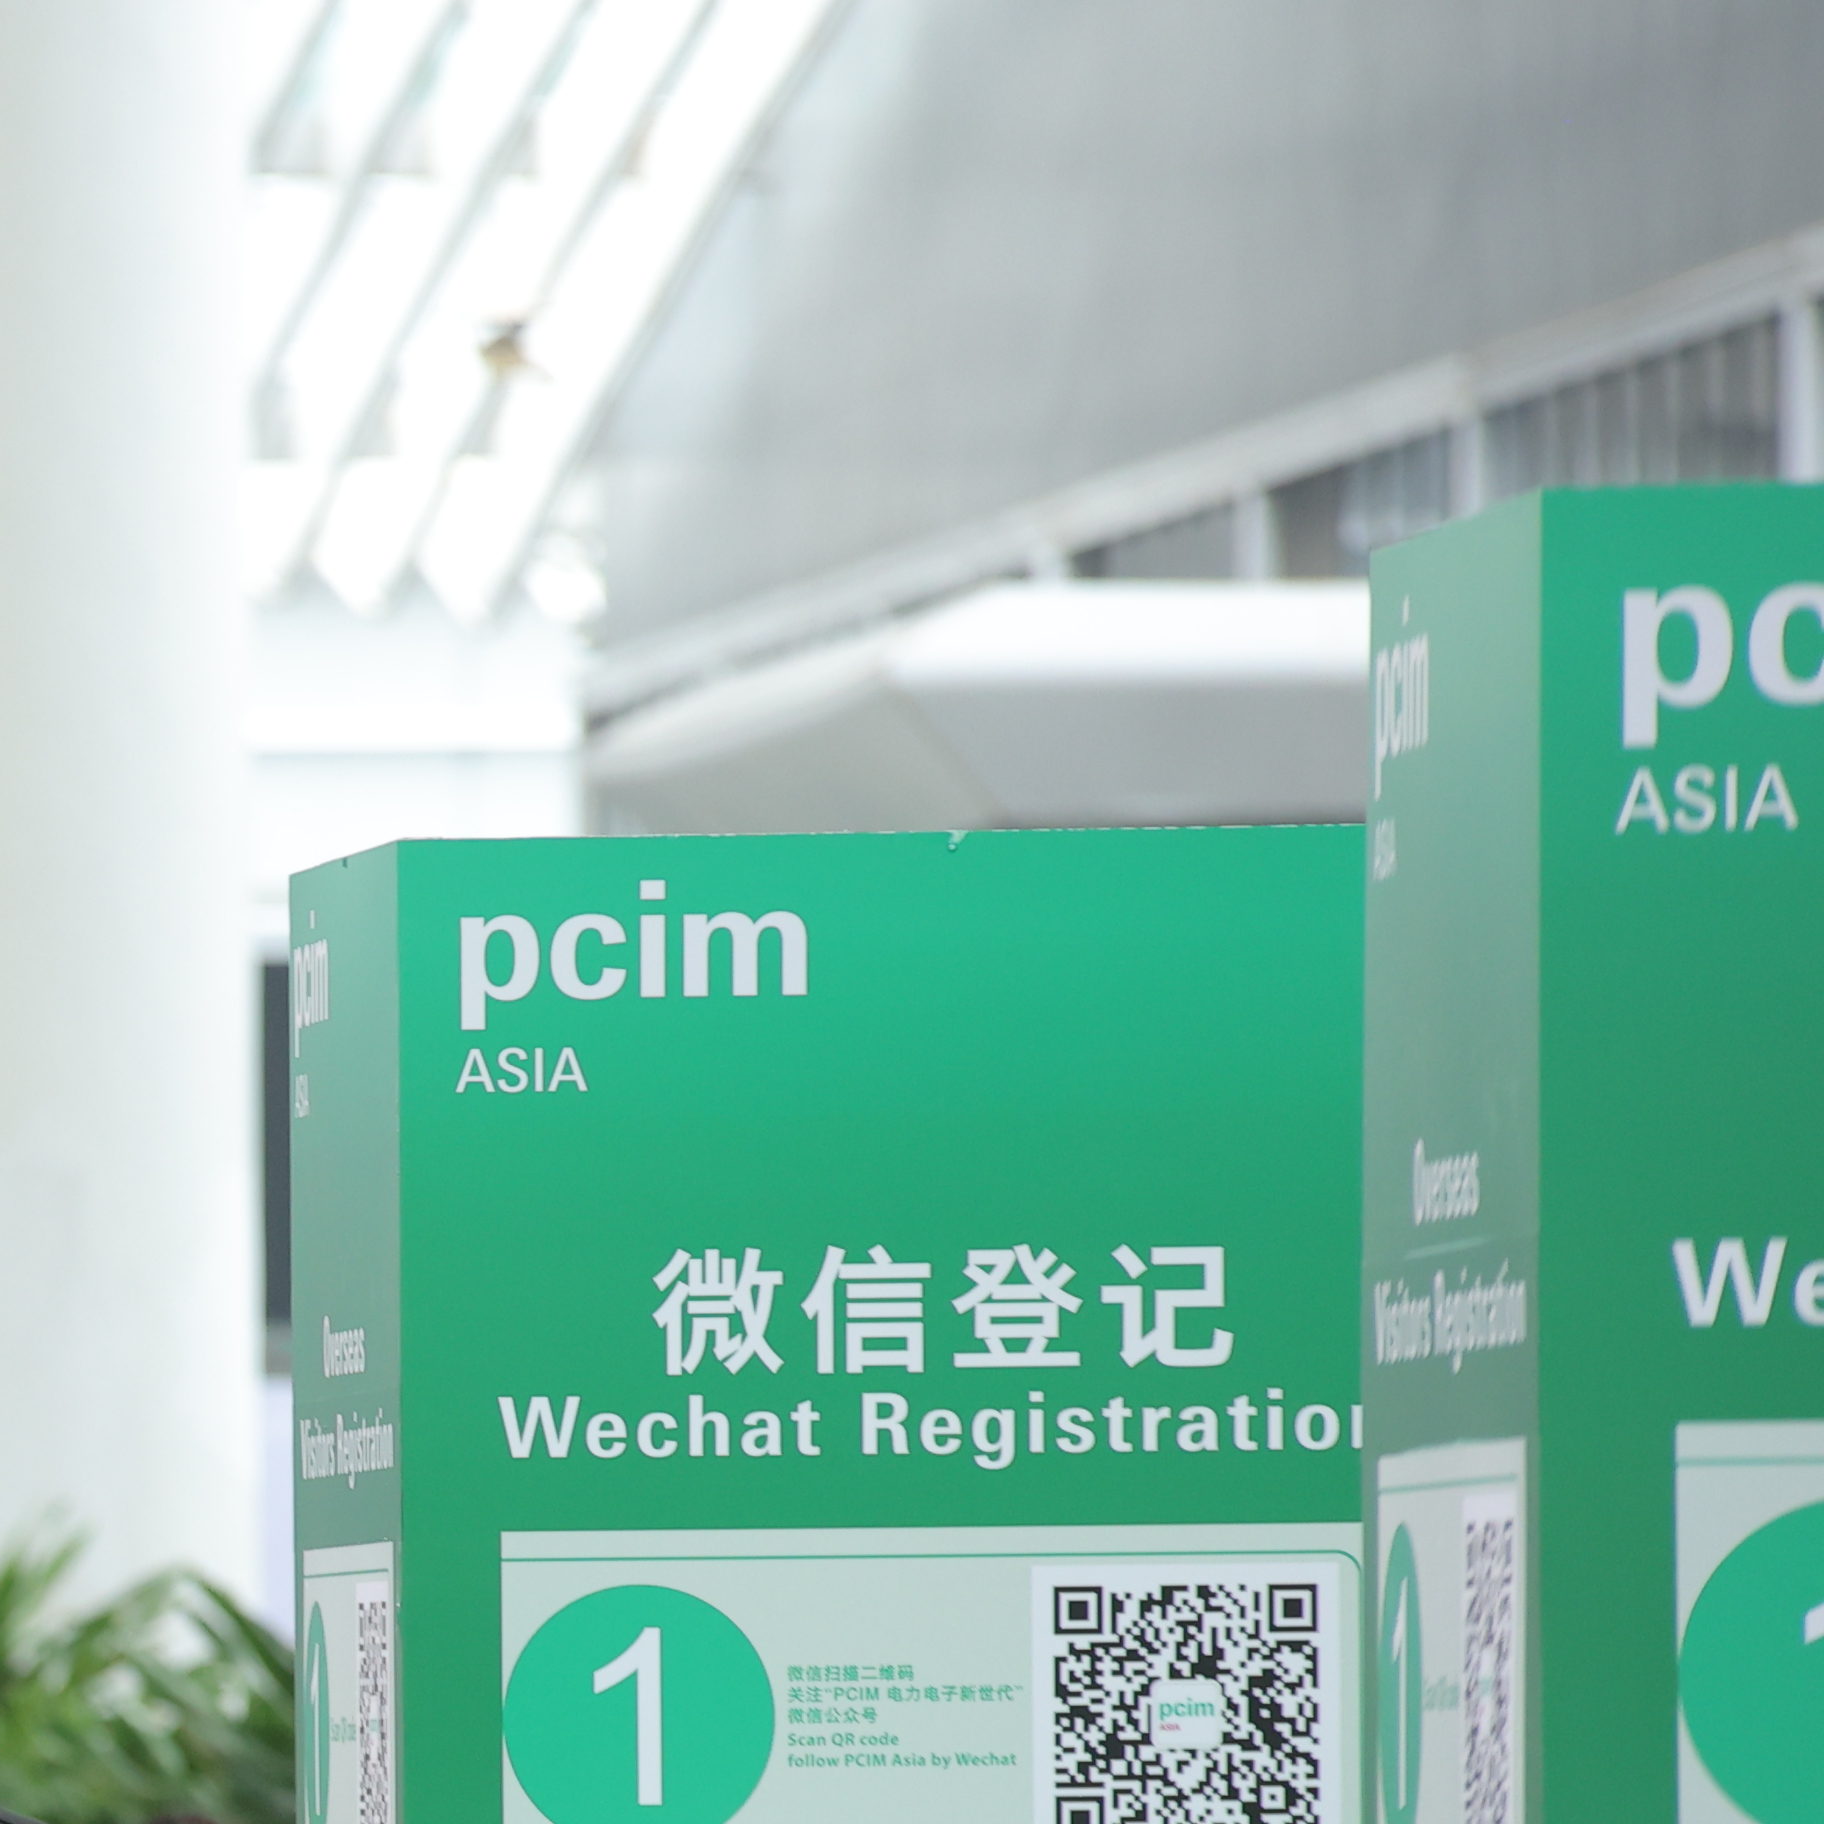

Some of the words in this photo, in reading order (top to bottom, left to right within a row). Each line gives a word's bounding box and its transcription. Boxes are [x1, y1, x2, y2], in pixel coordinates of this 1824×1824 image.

[1374, 596, 1429, 799] pcim
[1616, 765, 1799, 834] ASIA
[294, 909, 330, 1058] pcim
[459, 879, 810, 1032] pcim
[456, 1047, 589, 1094] ASIA
[1413, 1139, 1479, 1225] Overseas
[652, 1243, 1235, 1376] 微信登记
[323, 1315, 366, 1378] Overseas
[498, 1394, 822, 1460] Wechat
[861, 1388, 1363, 1471] Registratio
[787, 1665, 914, 1682] 微信扫描二维码
[593, 1627, 664, 1806] 1
[788, 1707, 878, 1724] 微信公众号
[788, 1733, 826, 1747] Scan
[831, 1733, 856, 1747] QR
[860, 1732, 900, 1747] code
[1159, 1697, 1215, 1721] pcim
[788, 1753, 840, 1768] follow
[844, 1753, 887, 1768] PCIM
[891, 1753, 927, 1767] Asia
[931, 1753, 952, 1770] by
[955, 1752, 1017, 1767] Wechat
